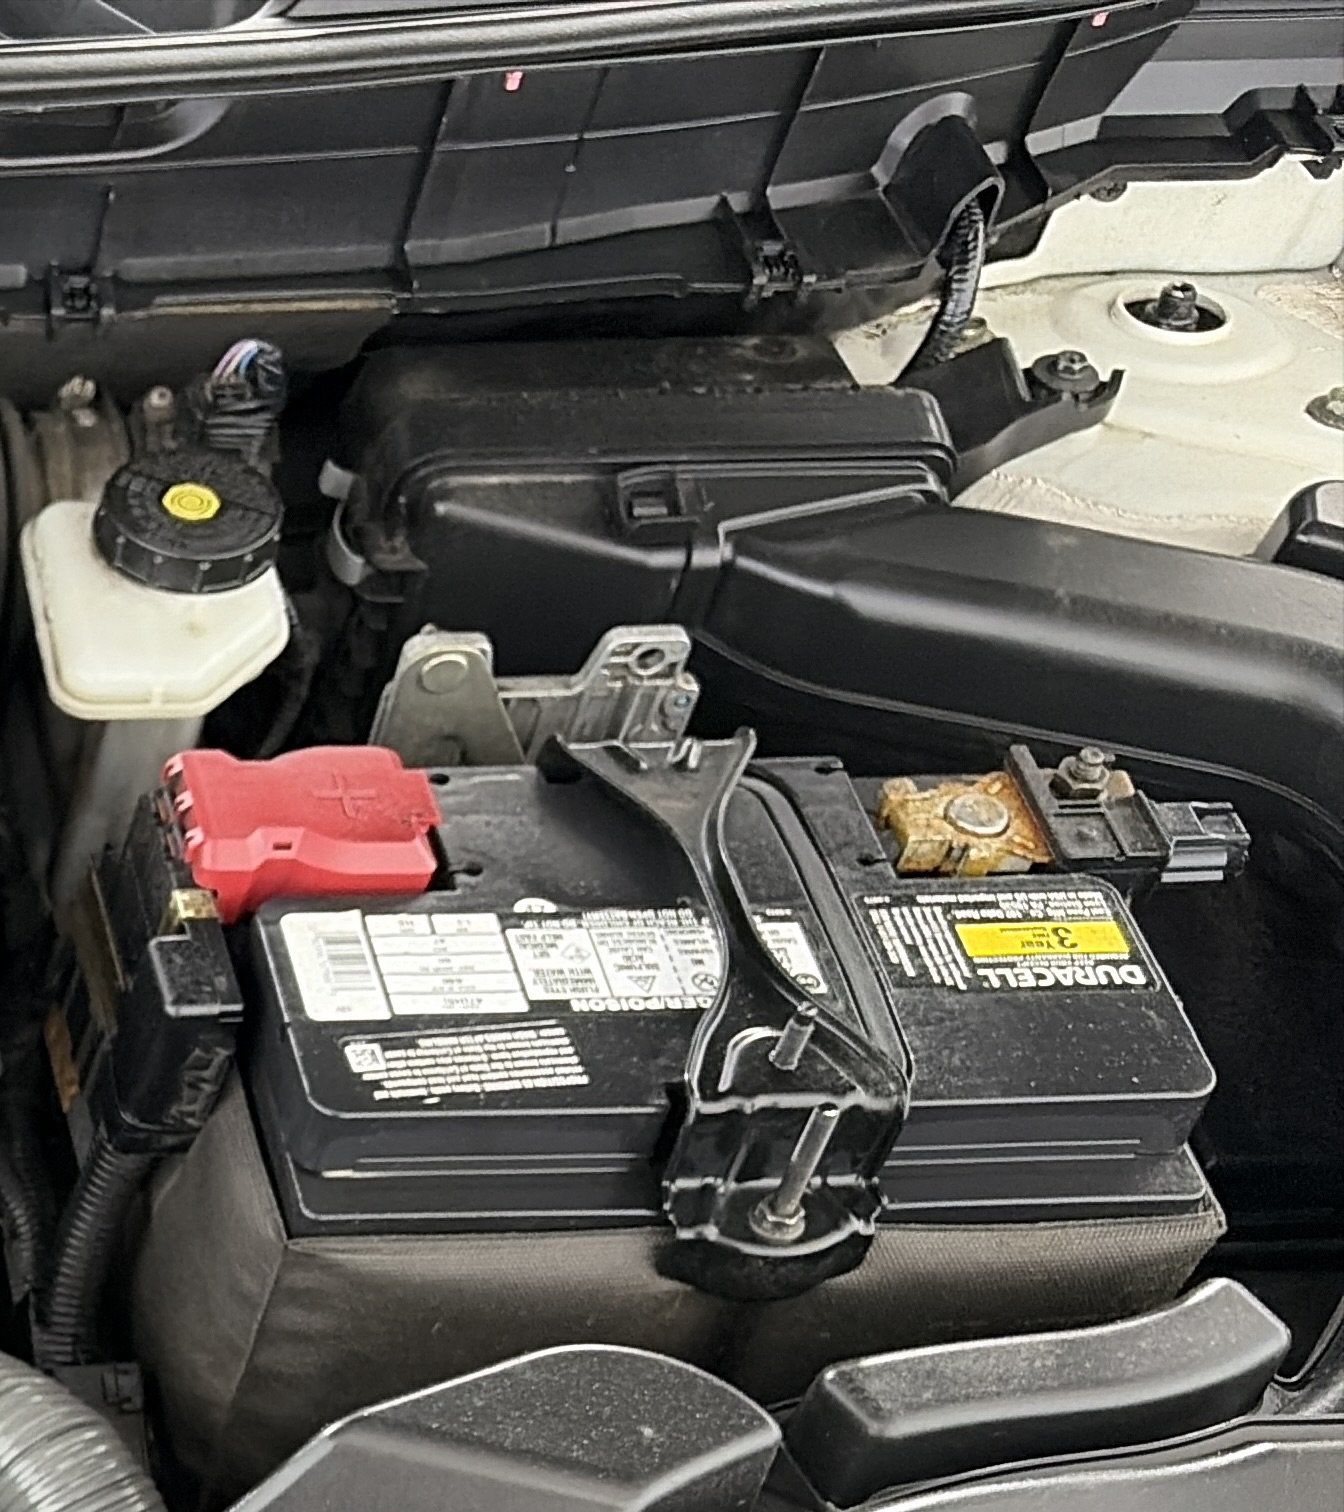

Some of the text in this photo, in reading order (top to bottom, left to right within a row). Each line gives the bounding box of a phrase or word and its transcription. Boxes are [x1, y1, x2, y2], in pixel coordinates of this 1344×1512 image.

[1021, 940, 1056, 950] Year
[1052, 926, 1079, 949] 3
[977, 965, 1147, 988] DURACELL
[570, 996, 713, 1012] GER/POISON
